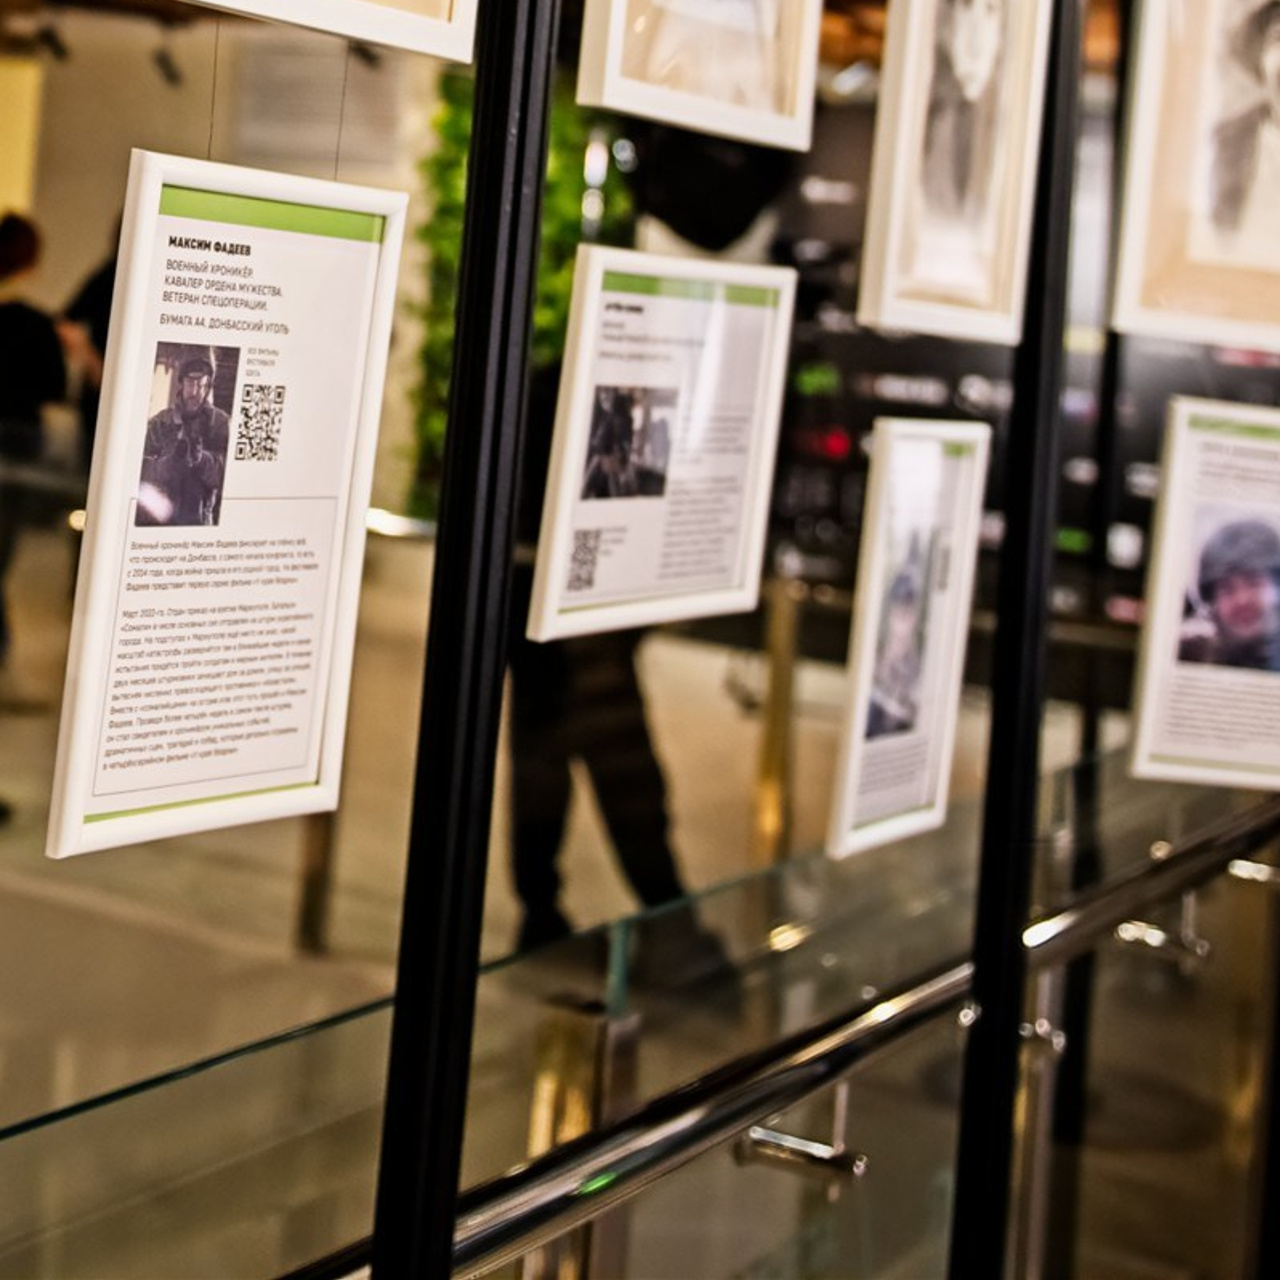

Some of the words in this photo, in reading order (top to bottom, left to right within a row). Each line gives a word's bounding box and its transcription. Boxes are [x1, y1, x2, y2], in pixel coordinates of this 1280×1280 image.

[169, 236, 211, 251] МАКСИМ
[214, 242, 250, 256] ФАДЕЕВ
[167, 259, 208, 272] ВОЕННЫЙ
[165, 276, 203, 288] КАВАЛЕР
[205, 280, 236, 291] ОРДЕНА
[163, 291, 199, 304] ВЕТЕРАН
[160, 314, 192, 326] БУМАГА
[209, 318, 263, 331] ДОНБАССКИЙ
[266, 324, 289, 334] УГОЛЬ
